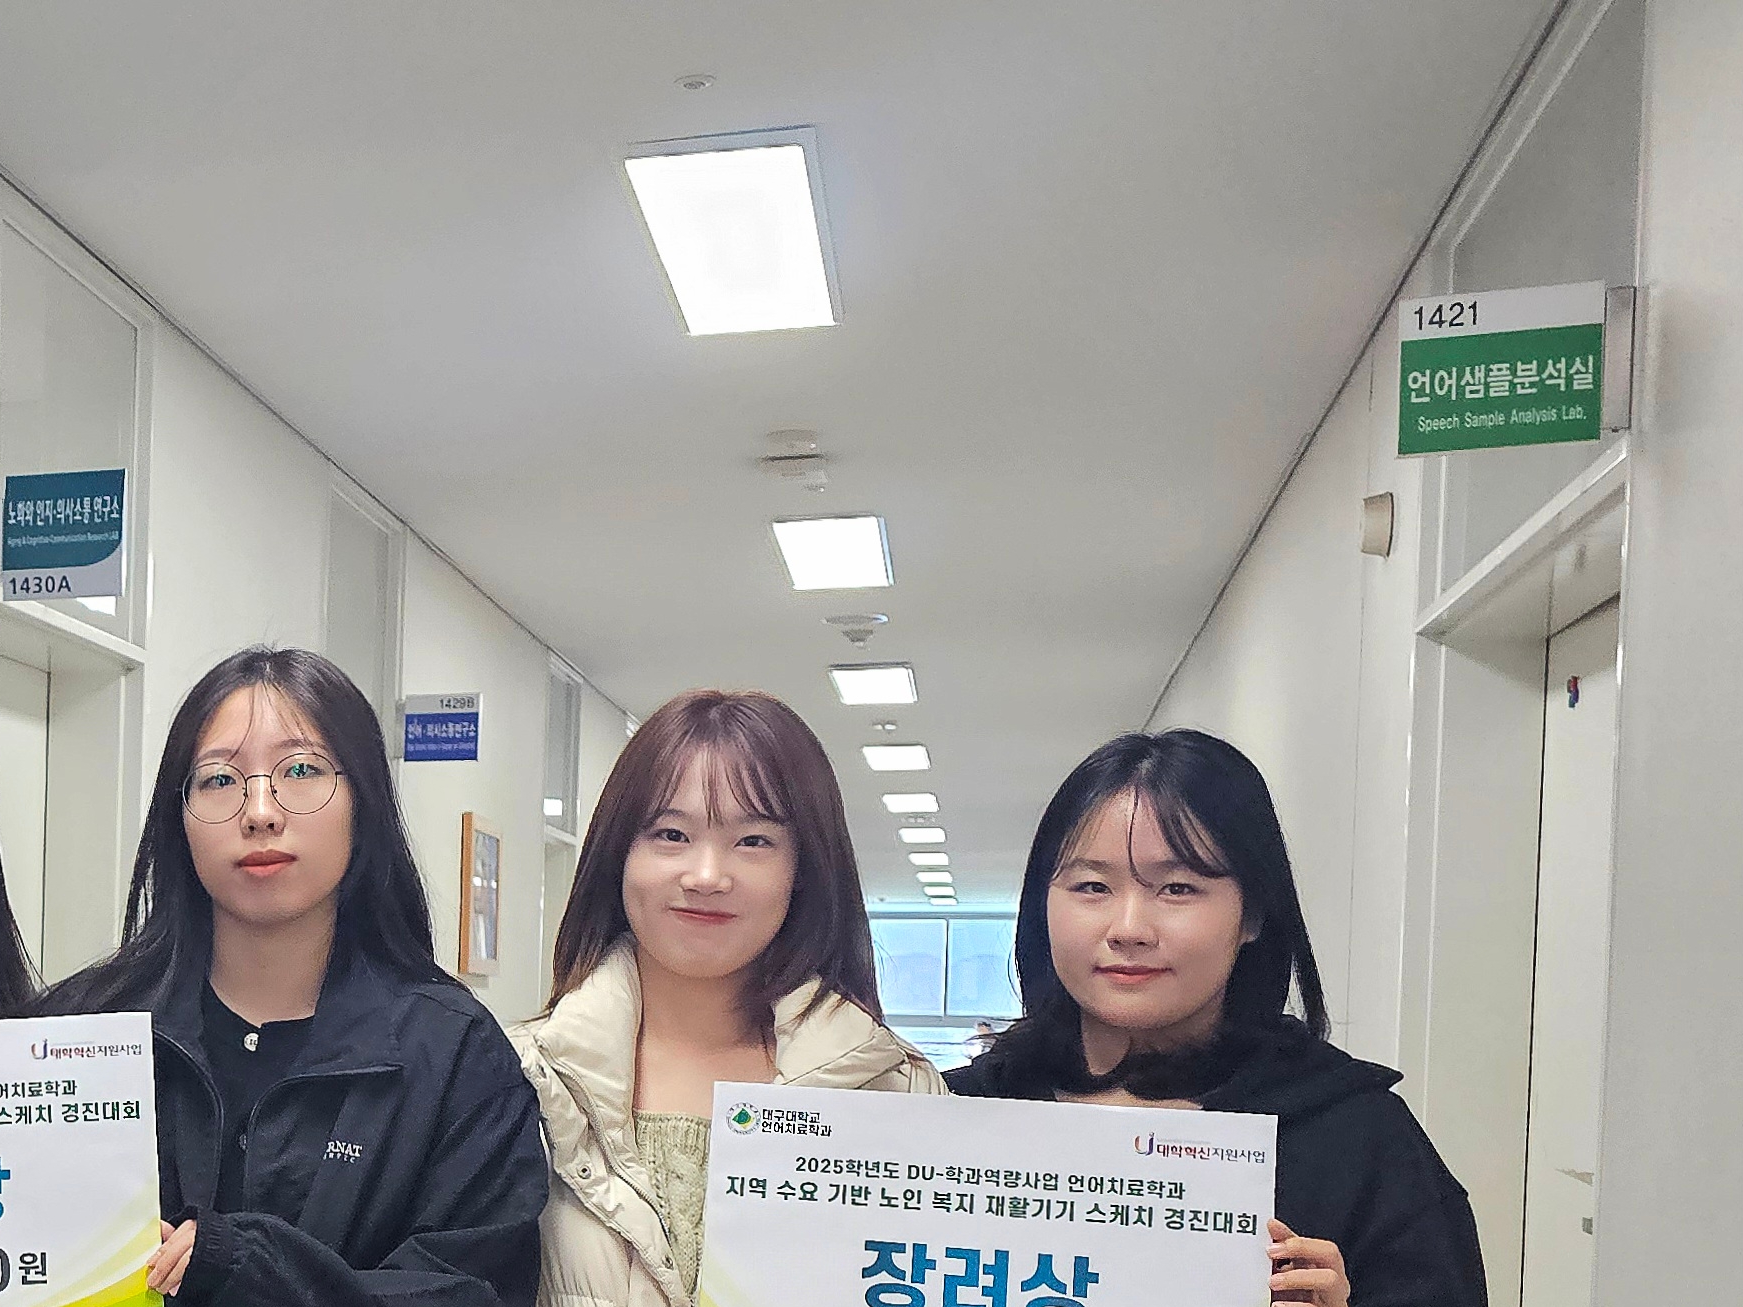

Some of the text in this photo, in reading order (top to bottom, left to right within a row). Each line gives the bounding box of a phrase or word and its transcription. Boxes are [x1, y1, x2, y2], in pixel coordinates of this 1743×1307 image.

[1414, 301, 1478, 330] 1421
[1408, 355, 1594, 403] 언어샘플분석실
[1418, 404, 1587, 434] Speech Sample Analysis Lab.
[94, 495, 119, 522] 연구소
[9, 575, 71, 594] 1430A
[50, 1044, 142, 1059] 대학혁신지원사업
[61, 1100, 141, 1123] 경진대회
[762, 1108, 820, 1124] 대구대학교
[761, 1121, 833, 1137] 언어치료학과
[1157, 1144, 1265, 1163] 대학혁신지원사업
[795, 1157, 1186, 1201] 2025학년도 DU-학과역량사업 언어치료학과
[726, 1176, 1257, 1236] 지역 수요 기반 노인 복지 재활기기 스케치 경진대회
